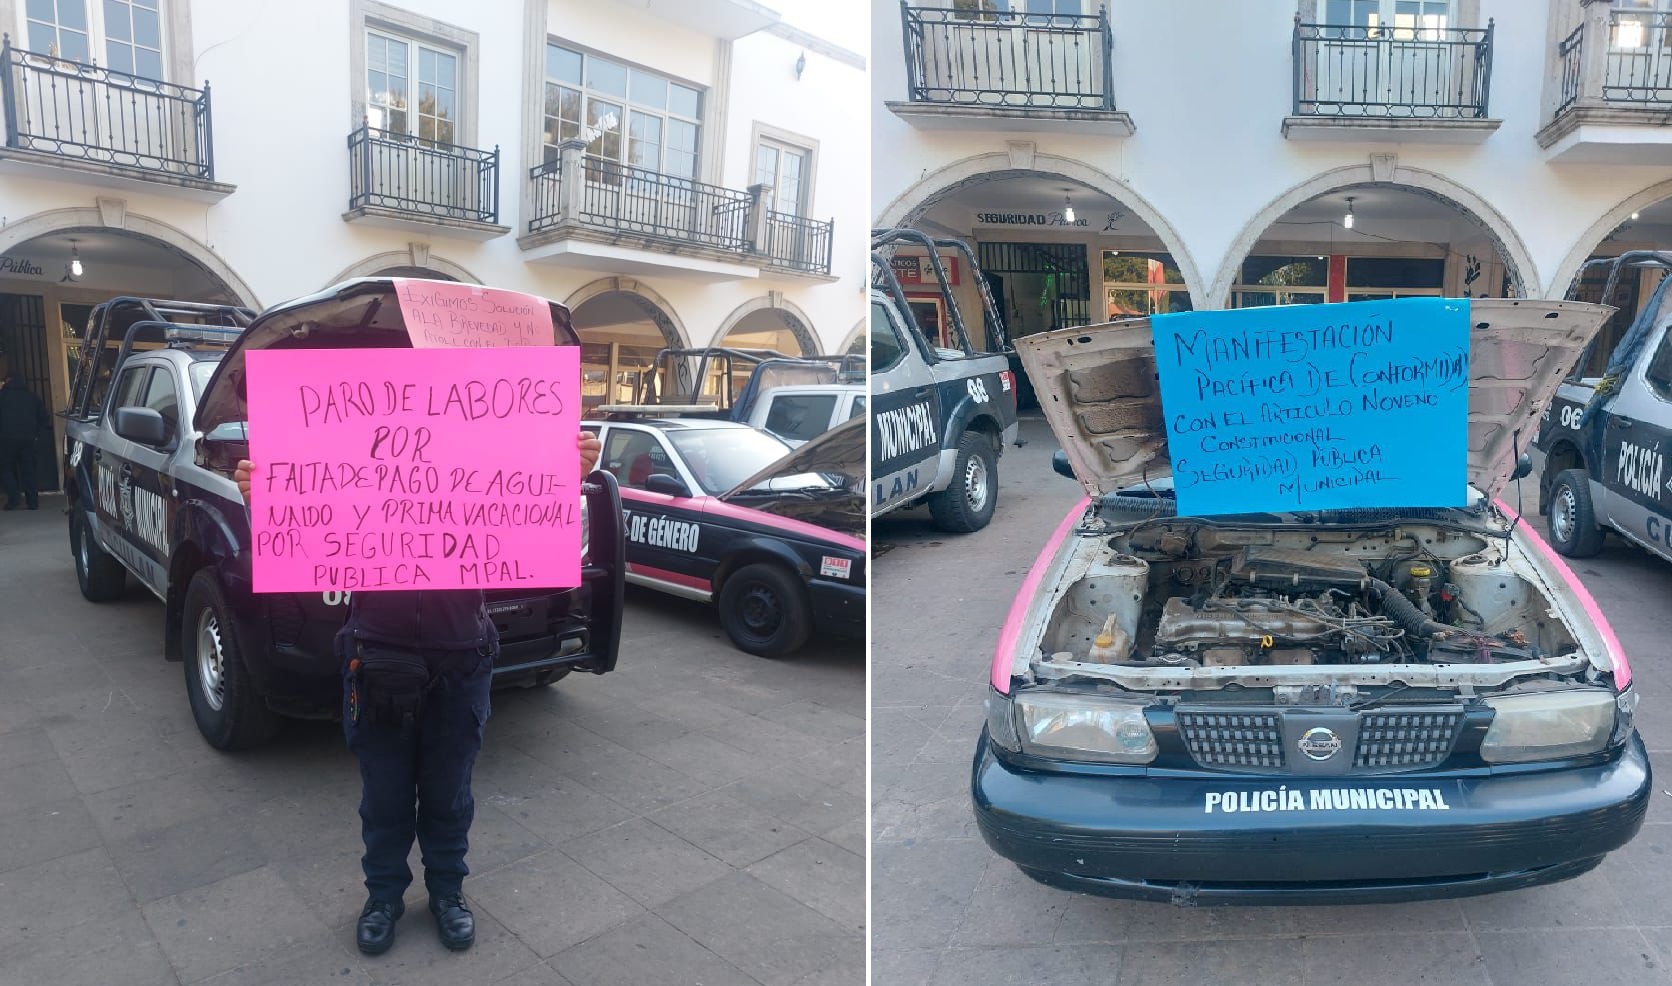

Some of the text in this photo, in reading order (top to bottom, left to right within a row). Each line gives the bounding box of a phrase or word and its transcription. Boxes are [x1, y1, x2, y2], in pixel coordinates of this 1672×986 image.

[977, 212, 1046, 225] SEGURIDAD
[1174, 313, 1393, 370] MANIFESTACIÓN
[1298, 362, 1345, 397] DE
[300, 377, 563, 428] PARO DE LABORES
[876, 401, 937, 462] MUNICIPAL
[1174, 412, 1216, 434] CON
[1224, 412, 1254, 427] EL
[370, 425, 432, 463] POR
[450, 467, 483, 493] DE
[1176, 450, 1298, 489] SEGURIDAD
[1279, 468, 1399, 504] MUNICIPAL
[1618, 440, 1663, 501] POLICÍA
[353, 504, 371, 531] Y
[381, 498, 457, 526] PRIMA
[463, 500, 575, 528] VACACIONAL
[257, 528, 500, 560] POR SEGURIDAD
[630, 514, 700, 553] DE GÉNERO
[314, 559, 534, 589] PUBLICA MPAL.
[1204, 785, 1450, 814] POLICÍA MUNICIPAL
